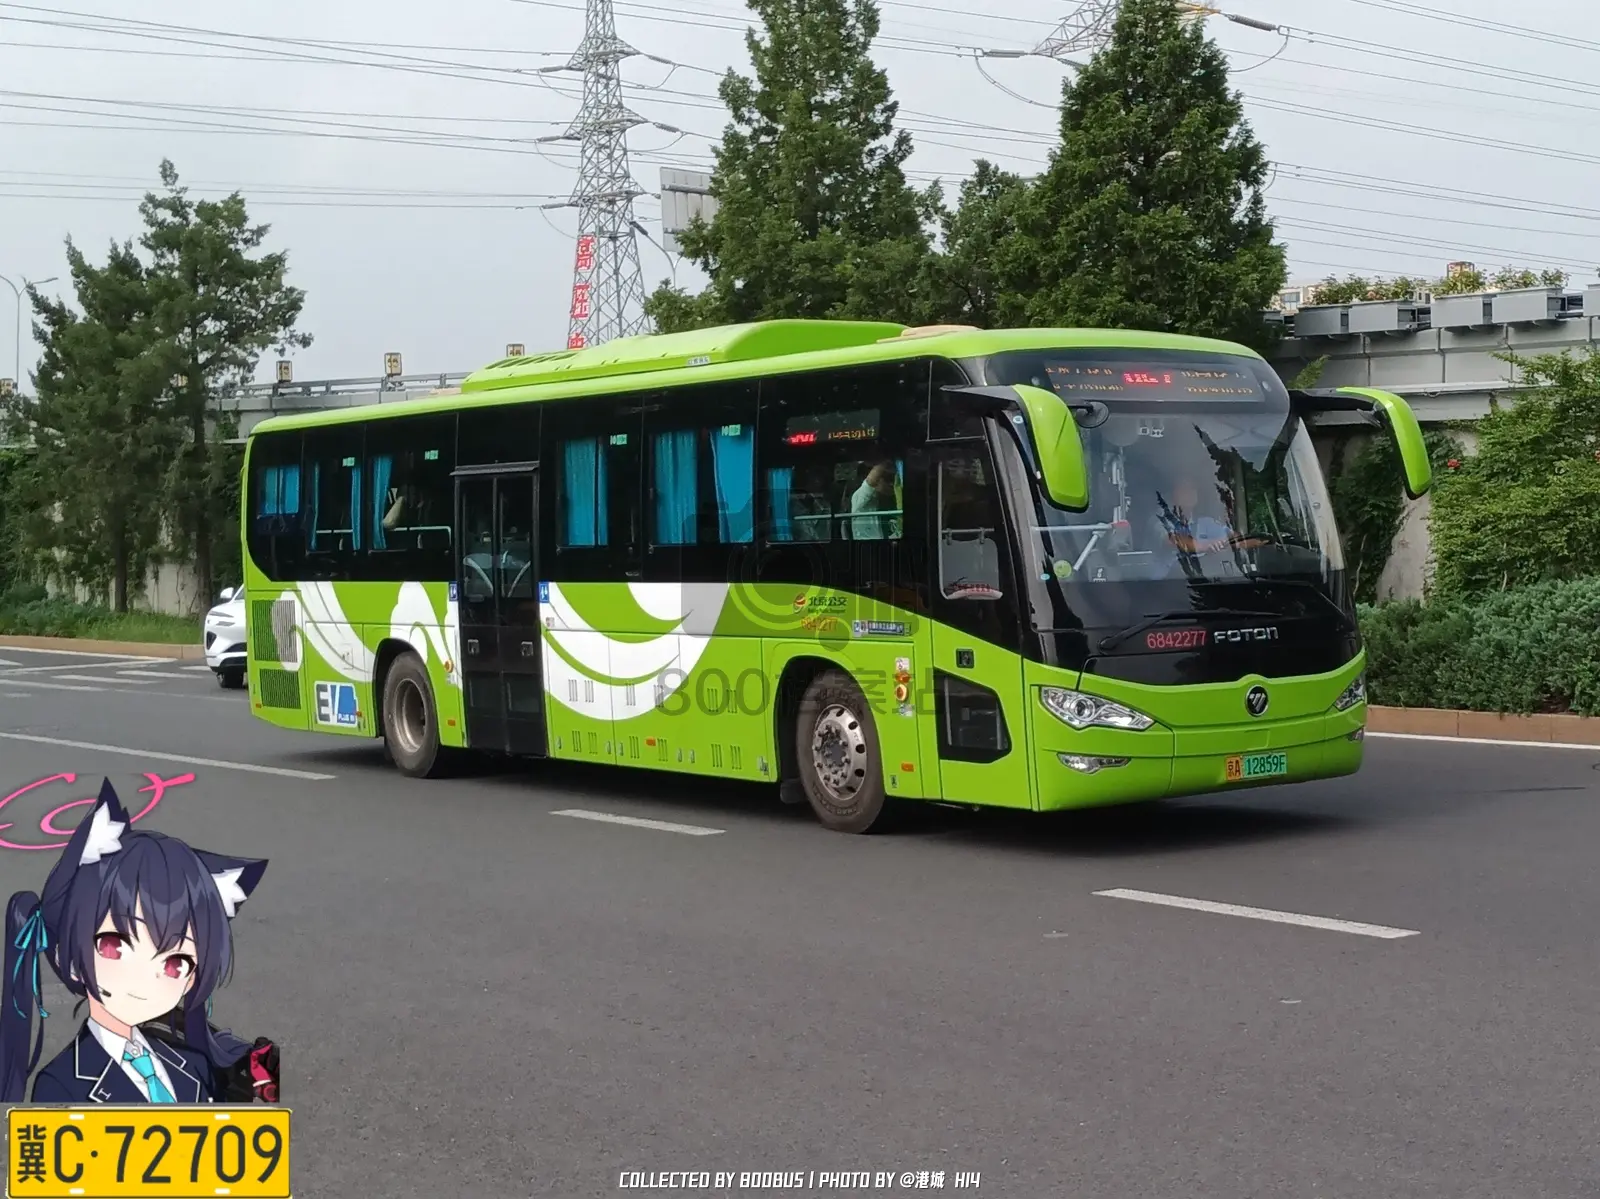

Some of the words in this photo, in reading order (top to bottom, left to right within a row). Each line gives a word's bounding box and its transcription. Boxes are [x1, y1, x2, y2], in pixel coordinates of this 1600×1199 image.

[808, 596, 847, 607] 北京公交
[1147, 631, 1207, 648] 6842277
[1213, 626, 1279, 644] FOTON
